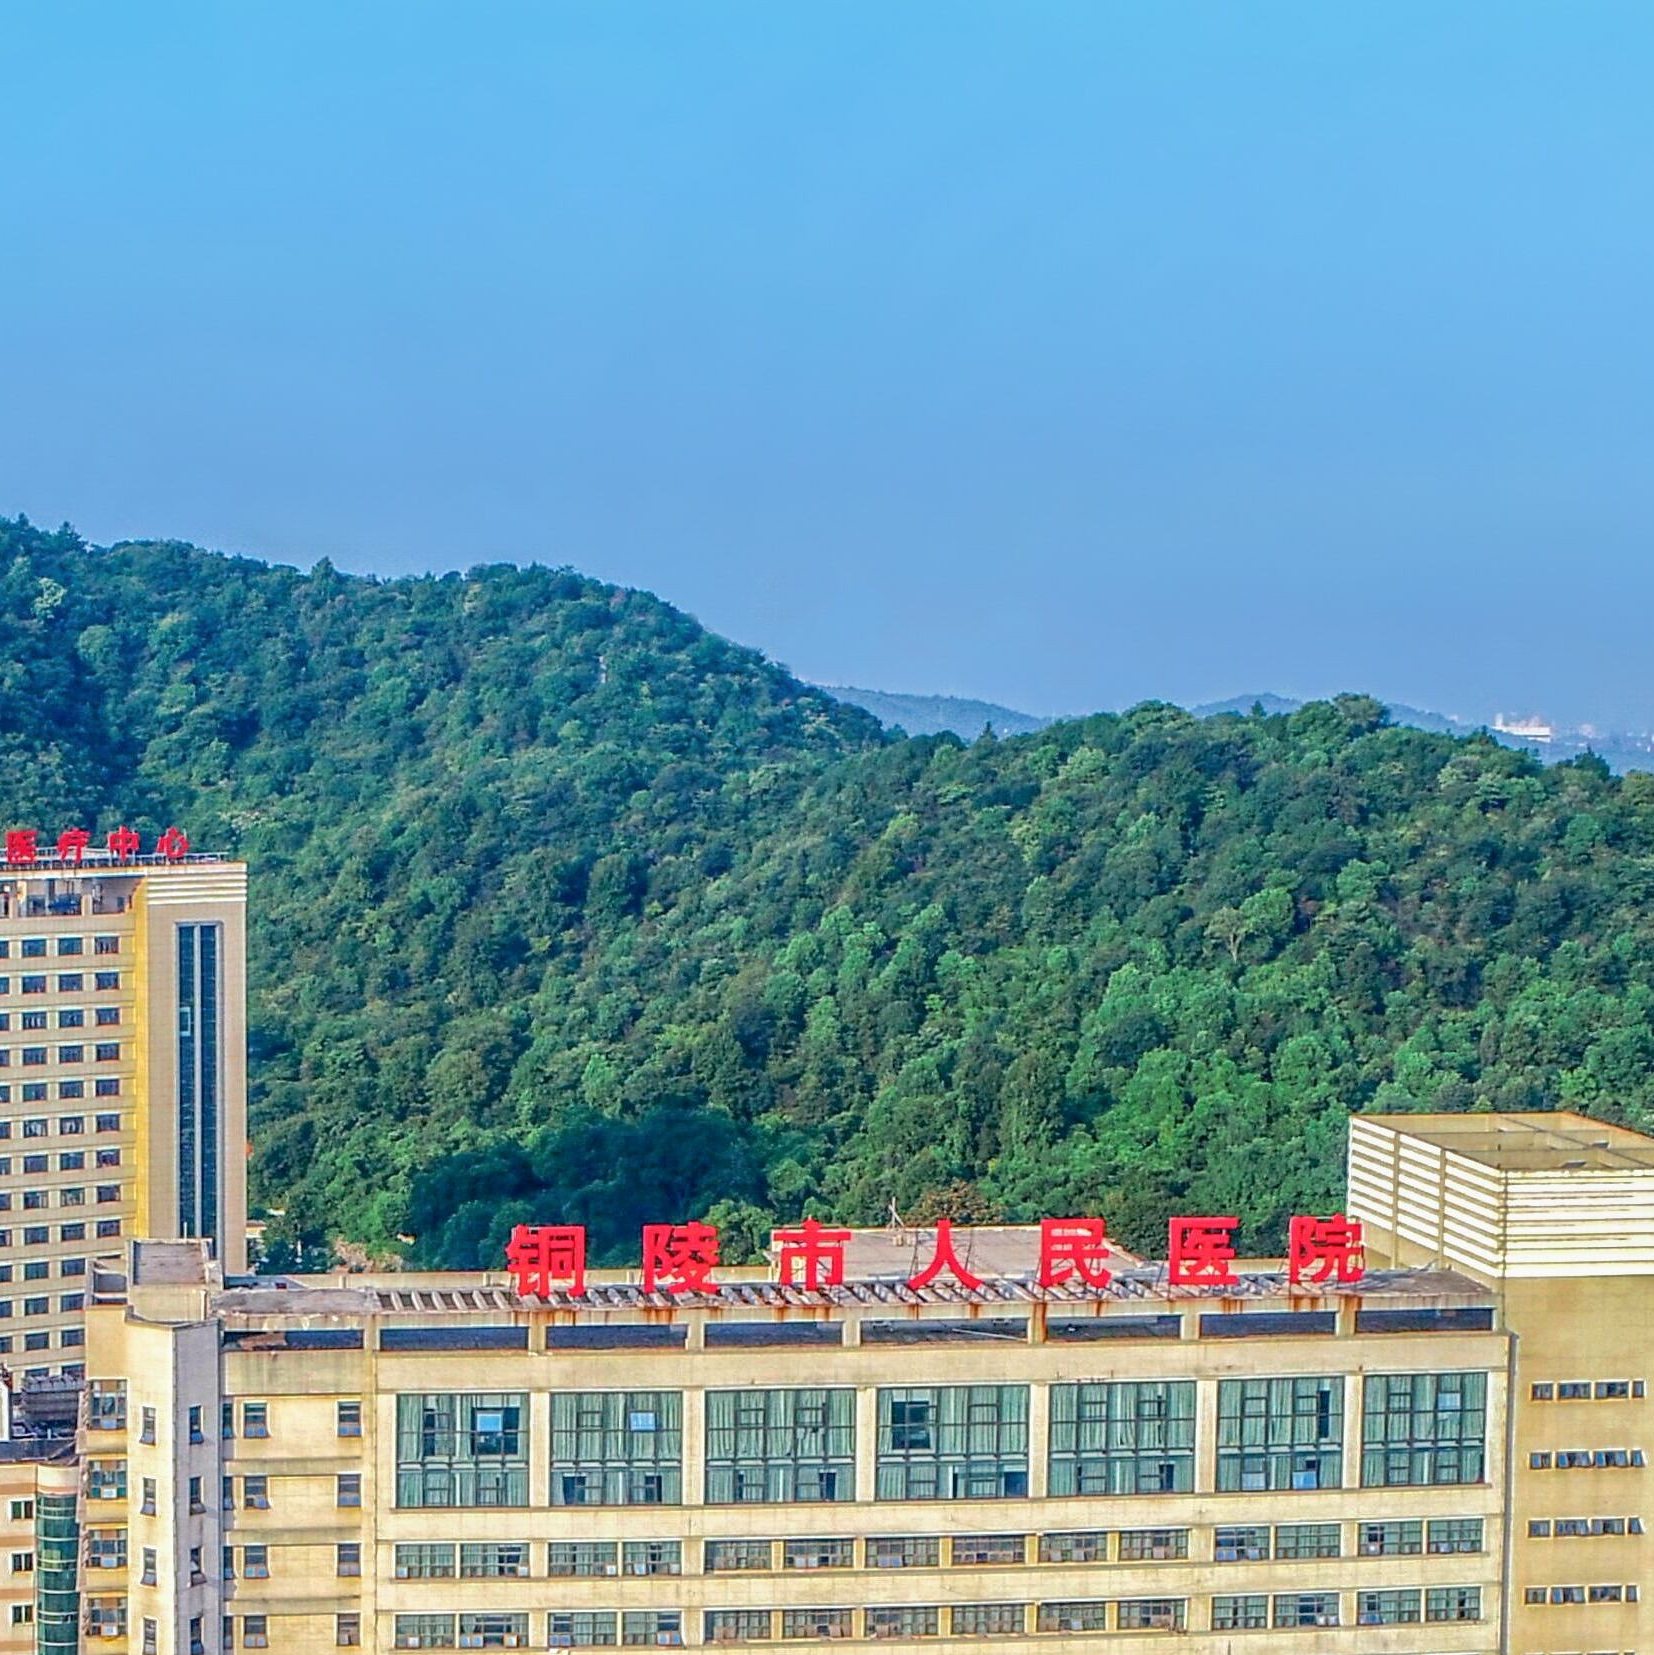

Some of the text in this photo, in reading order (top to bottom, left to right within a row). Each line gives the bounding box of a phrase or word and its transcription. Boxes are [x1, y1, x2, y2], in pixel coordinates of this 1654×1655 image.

[506, 1213, 1365, 1298] 铜陵市人民医院
